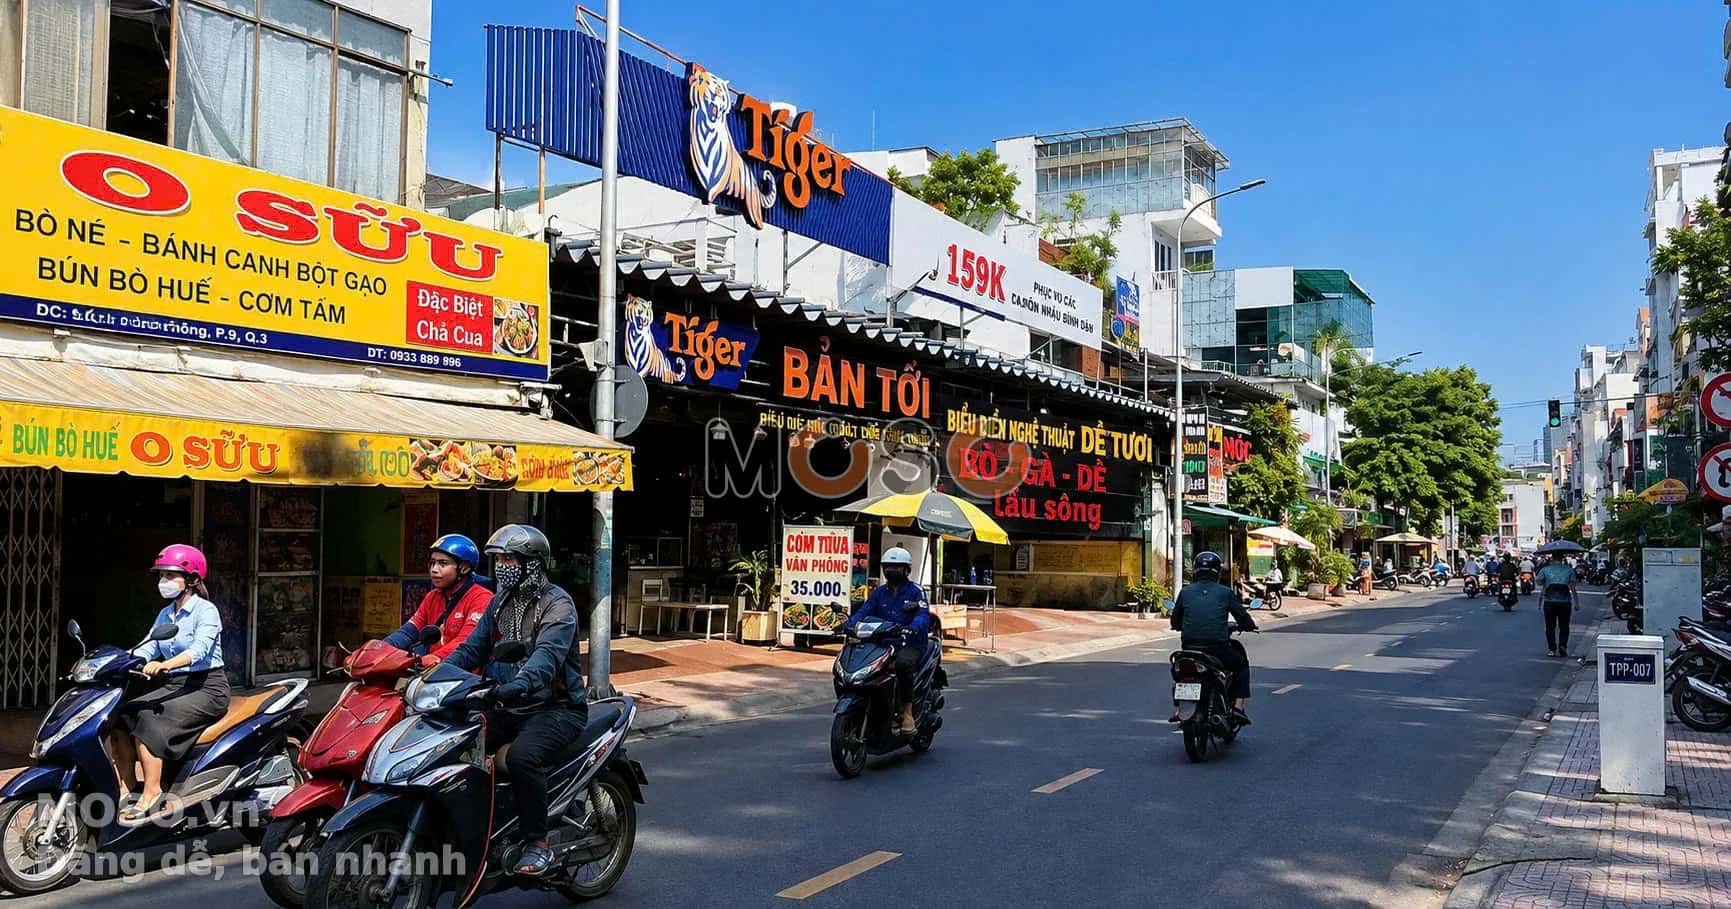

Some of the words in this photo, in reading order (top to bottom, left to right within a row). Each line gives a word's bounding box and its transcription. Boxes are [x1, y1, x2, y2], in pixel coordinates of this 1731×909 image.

[741, 94, 852, 208] Tiger
[60, 149, 191, 215] O
[234, 190, 503, 281] SỮU
[16, 209, 57, 236] BÒ
[68, 218, 105, 246] NÉ
[143, 232, 216, 265] BÁNH
[225, 250, 289, 278] CANH
[297, 261, 338, 288] BỘT
[345, 272, 387, 296] GẠO
[946, 244, 1007, 303] 159K
[38, 256, 98, 287] BÚN
[110, 267, 148, 294] BÒ
[158, 277, 212, 304] HUẾ
[239, 290, 292, 316] CƠM
[300, 297, 345, 324] TẤM
[417, 288, 449, 314] Đặc
[453, 294, 484, 320] Biệt
[245, 331, 268, 345] Q.3
[390, 350, 417, 362] 0933
[416, 319, 449, 342] Chả
[453, 325, 483, 347] Cua
[664, 311, 746, 381] Tiger
[783, 335, 865, 409] BẢN
[12, 417, 49, 456] BÚN
[55, 422, 77, 458] BÒ
[82, 421, 119, 460] HUẾ
[130, 432, 173, 466] O
[183, 430, 280, 474] SỮU
[959, 442, 998, 480] BÒ
[1020, 450, 1056, 488] GÀ
[1044, 492, 1101, 531] sông
[1609, 663, 1651, 677] TPP-007
